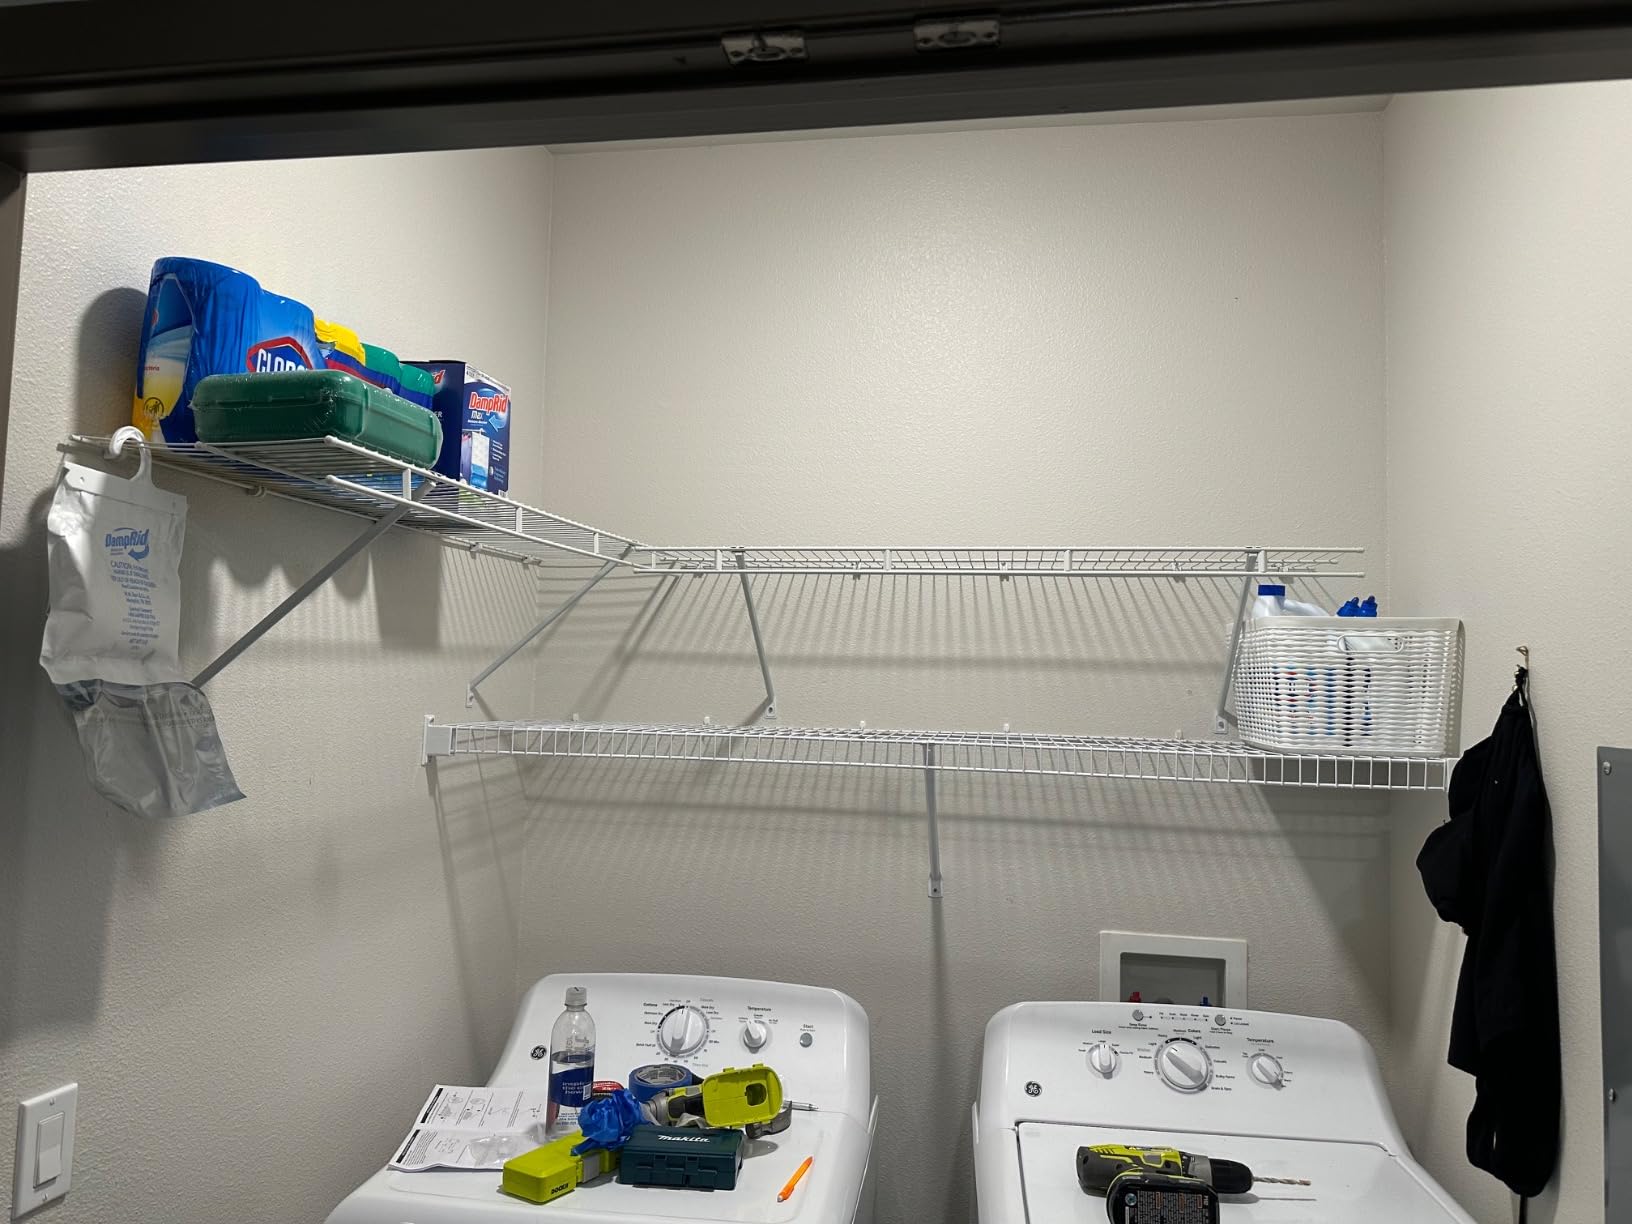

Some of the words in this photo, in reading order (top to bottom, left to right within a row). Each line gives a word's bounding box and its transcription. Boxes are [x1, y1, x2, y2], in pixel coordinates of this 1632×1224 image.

[256, 348, 308, 373] CLO
[469, 391, 509, 415] DampRid
[105, 529, 150, 549] DampRid
[657, 1134, 710, 1143] makita
